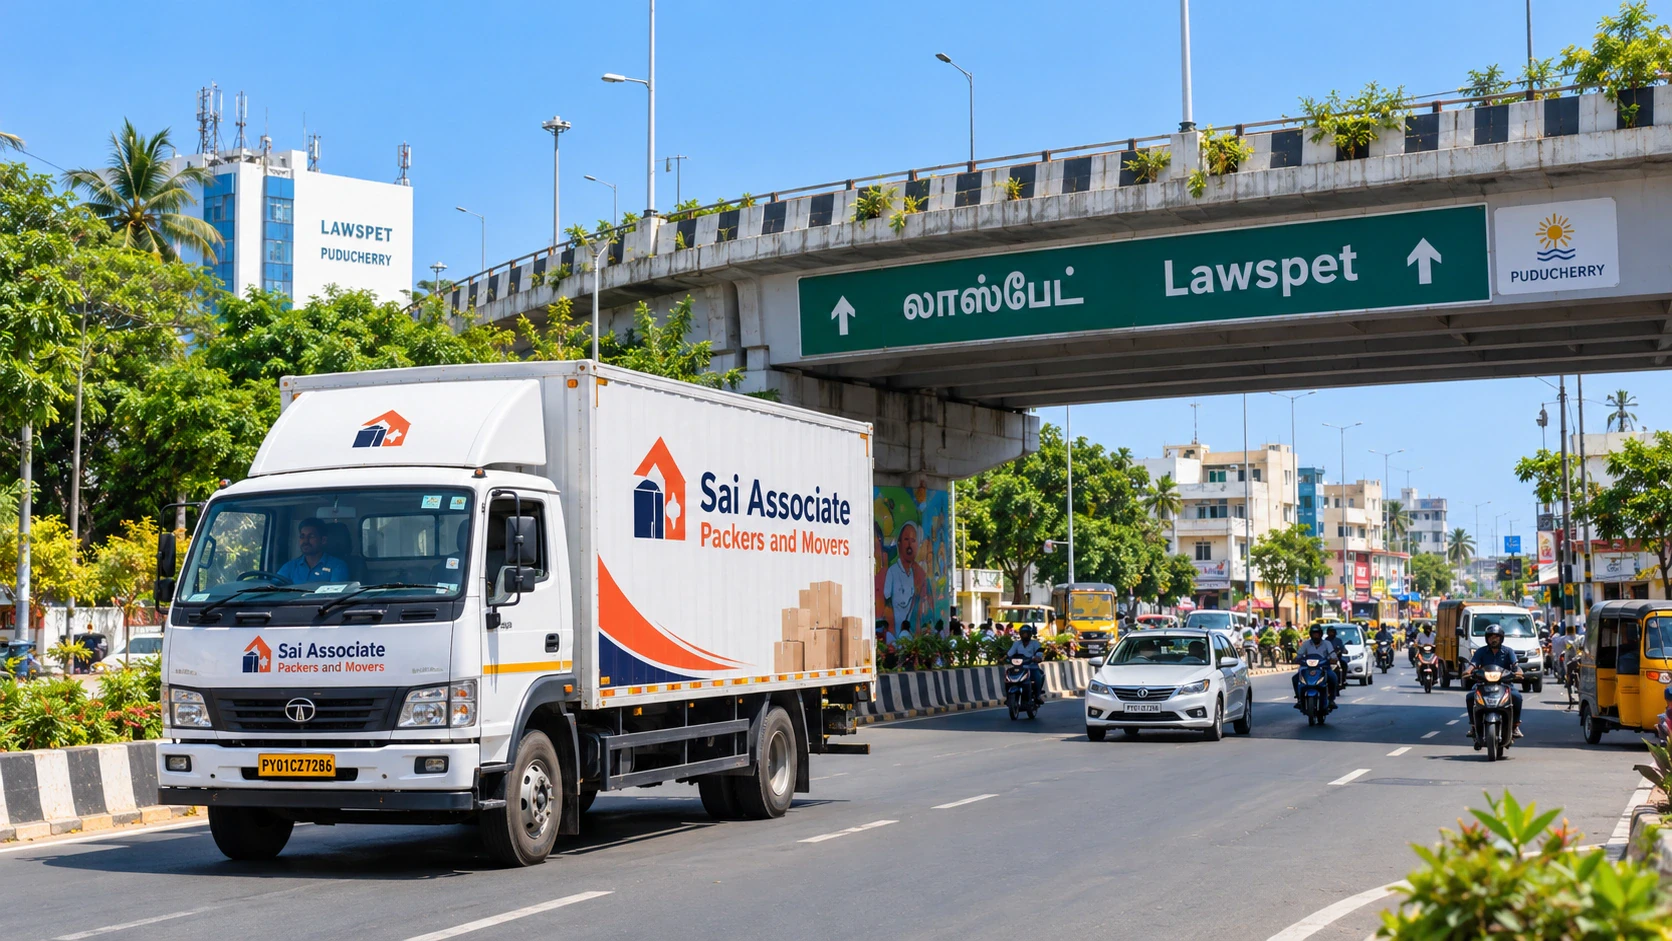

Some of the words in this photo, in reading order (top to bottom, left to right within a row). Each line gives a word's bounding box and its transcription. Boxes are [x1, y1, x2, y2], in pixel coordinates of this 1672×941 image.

[321, 220, 393, 242] LAWSPET
[321, 247, 392, 266] PUDUCHERRY
[1164, 244, 1358, 297] Lawspet
[1511, 264, 1605, 282] PUDUCHERRY
[903, 266, 1084, 320] லாஸ்பேட்
[700, 471, 739, 514] Sai
[747, 479, 850, 525] Associate
[700, 521, 764, 551] Packers
[770, 529, 797, 553] and
[802, 530, 849, 556] Movers
[278, 642, 302, 659] Sai
[306, 641, 385, 659] Associate
[278, 662, 319, 673] Packers
[322, 662, 342, 672] and
[345, 661, 385, 672] Movers
[262, 759, 332, 772] PY01CZ7286
